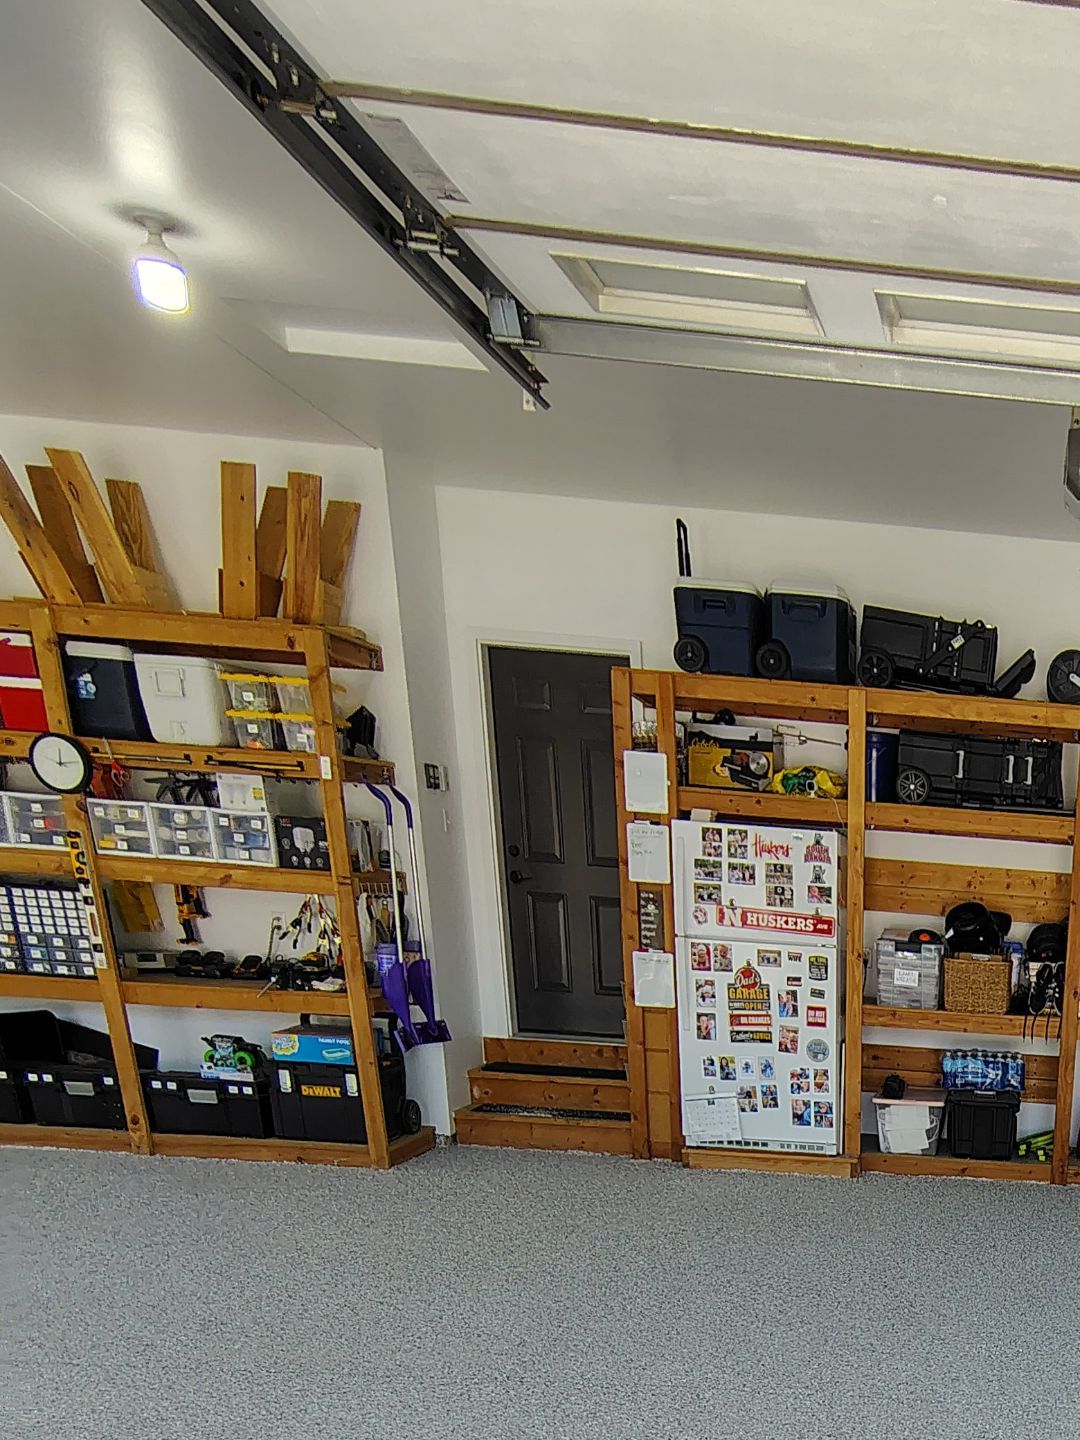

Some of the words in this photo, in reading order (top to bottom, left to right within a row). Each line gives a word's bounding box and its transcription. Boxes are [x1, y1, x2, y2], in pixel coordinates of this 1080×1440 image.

[753, 833, 793, 861] Huskers
[723, 907, 743, 928] N
[746, 912, 815, 932] HUSKERS
[728, 987, 769, 1000] GARAGE
